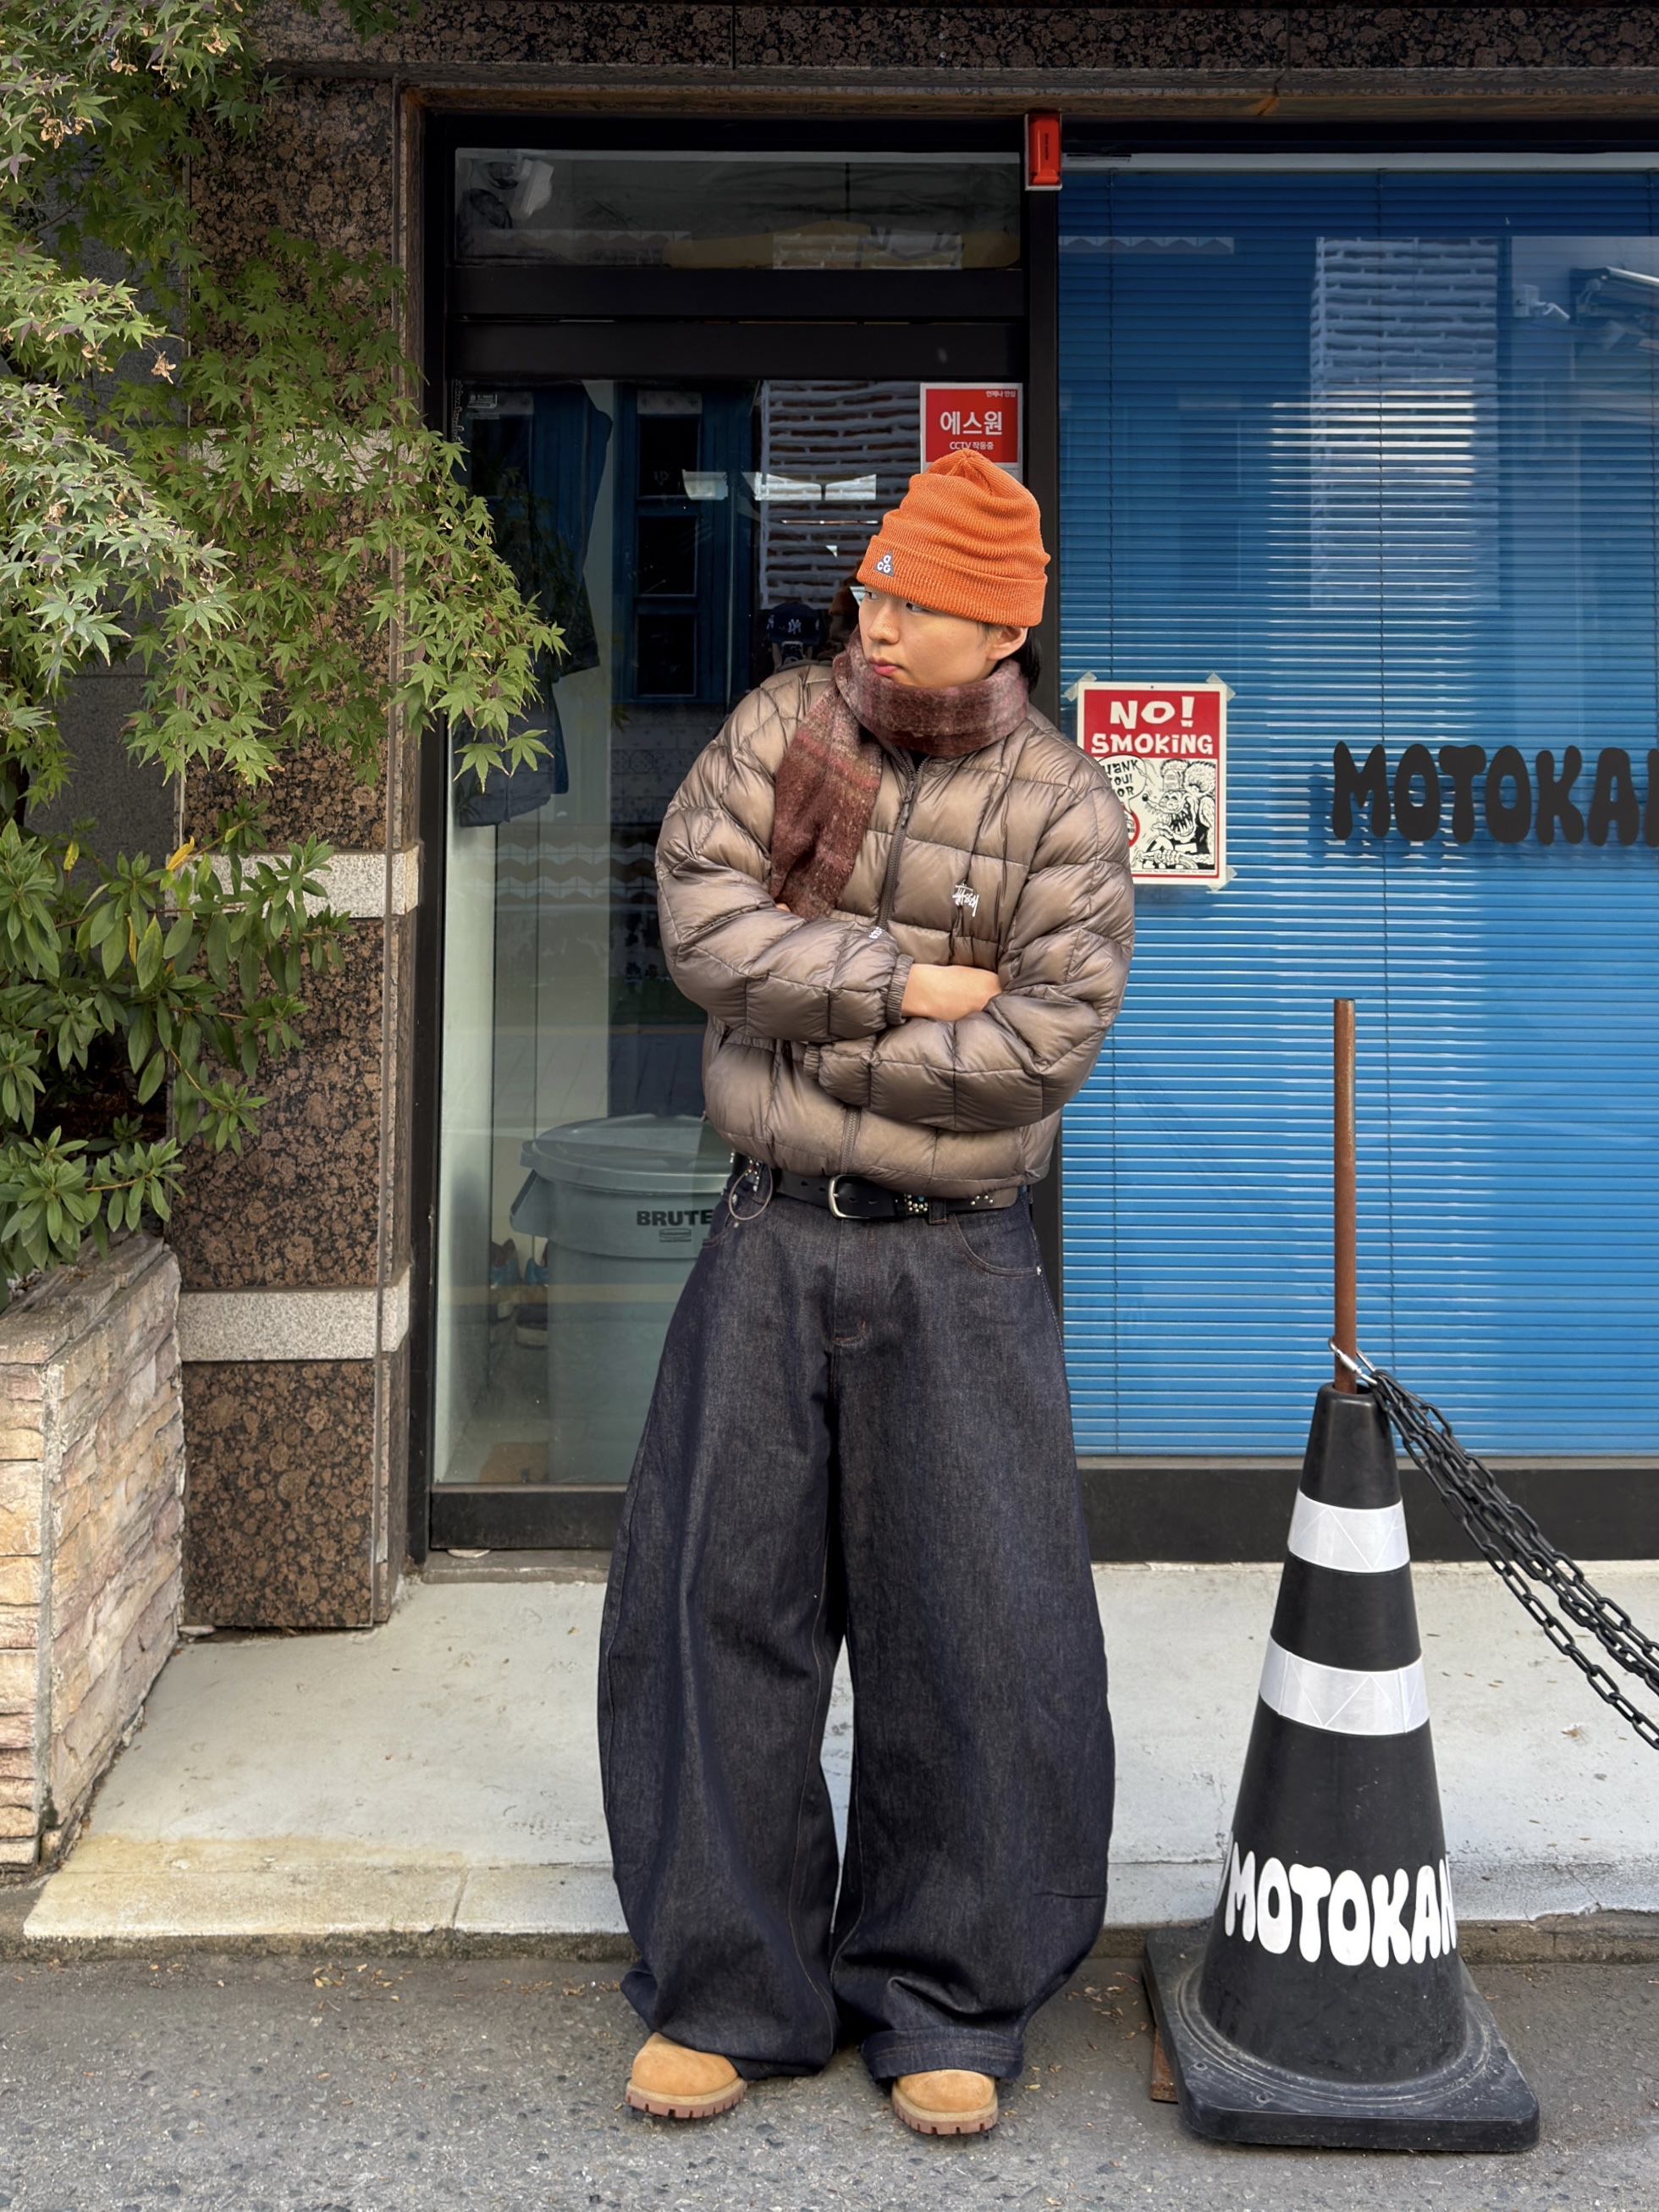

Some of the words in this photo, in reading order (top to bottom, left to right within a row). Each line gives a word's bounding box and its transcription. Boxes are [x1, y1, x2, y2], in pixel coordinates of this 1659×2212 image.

[940, 411, 1002, 435] 에스원
[949, 441, 972, 450] CCTV
[973, 441, 994, 450] 작동중
[1110, 696, 1195, 730] NO!
[1111, 773, 1133, 786] OU!
[1116, 786, 1134, 797] OR
[637, 1210, 713, 1226] BRUTE
